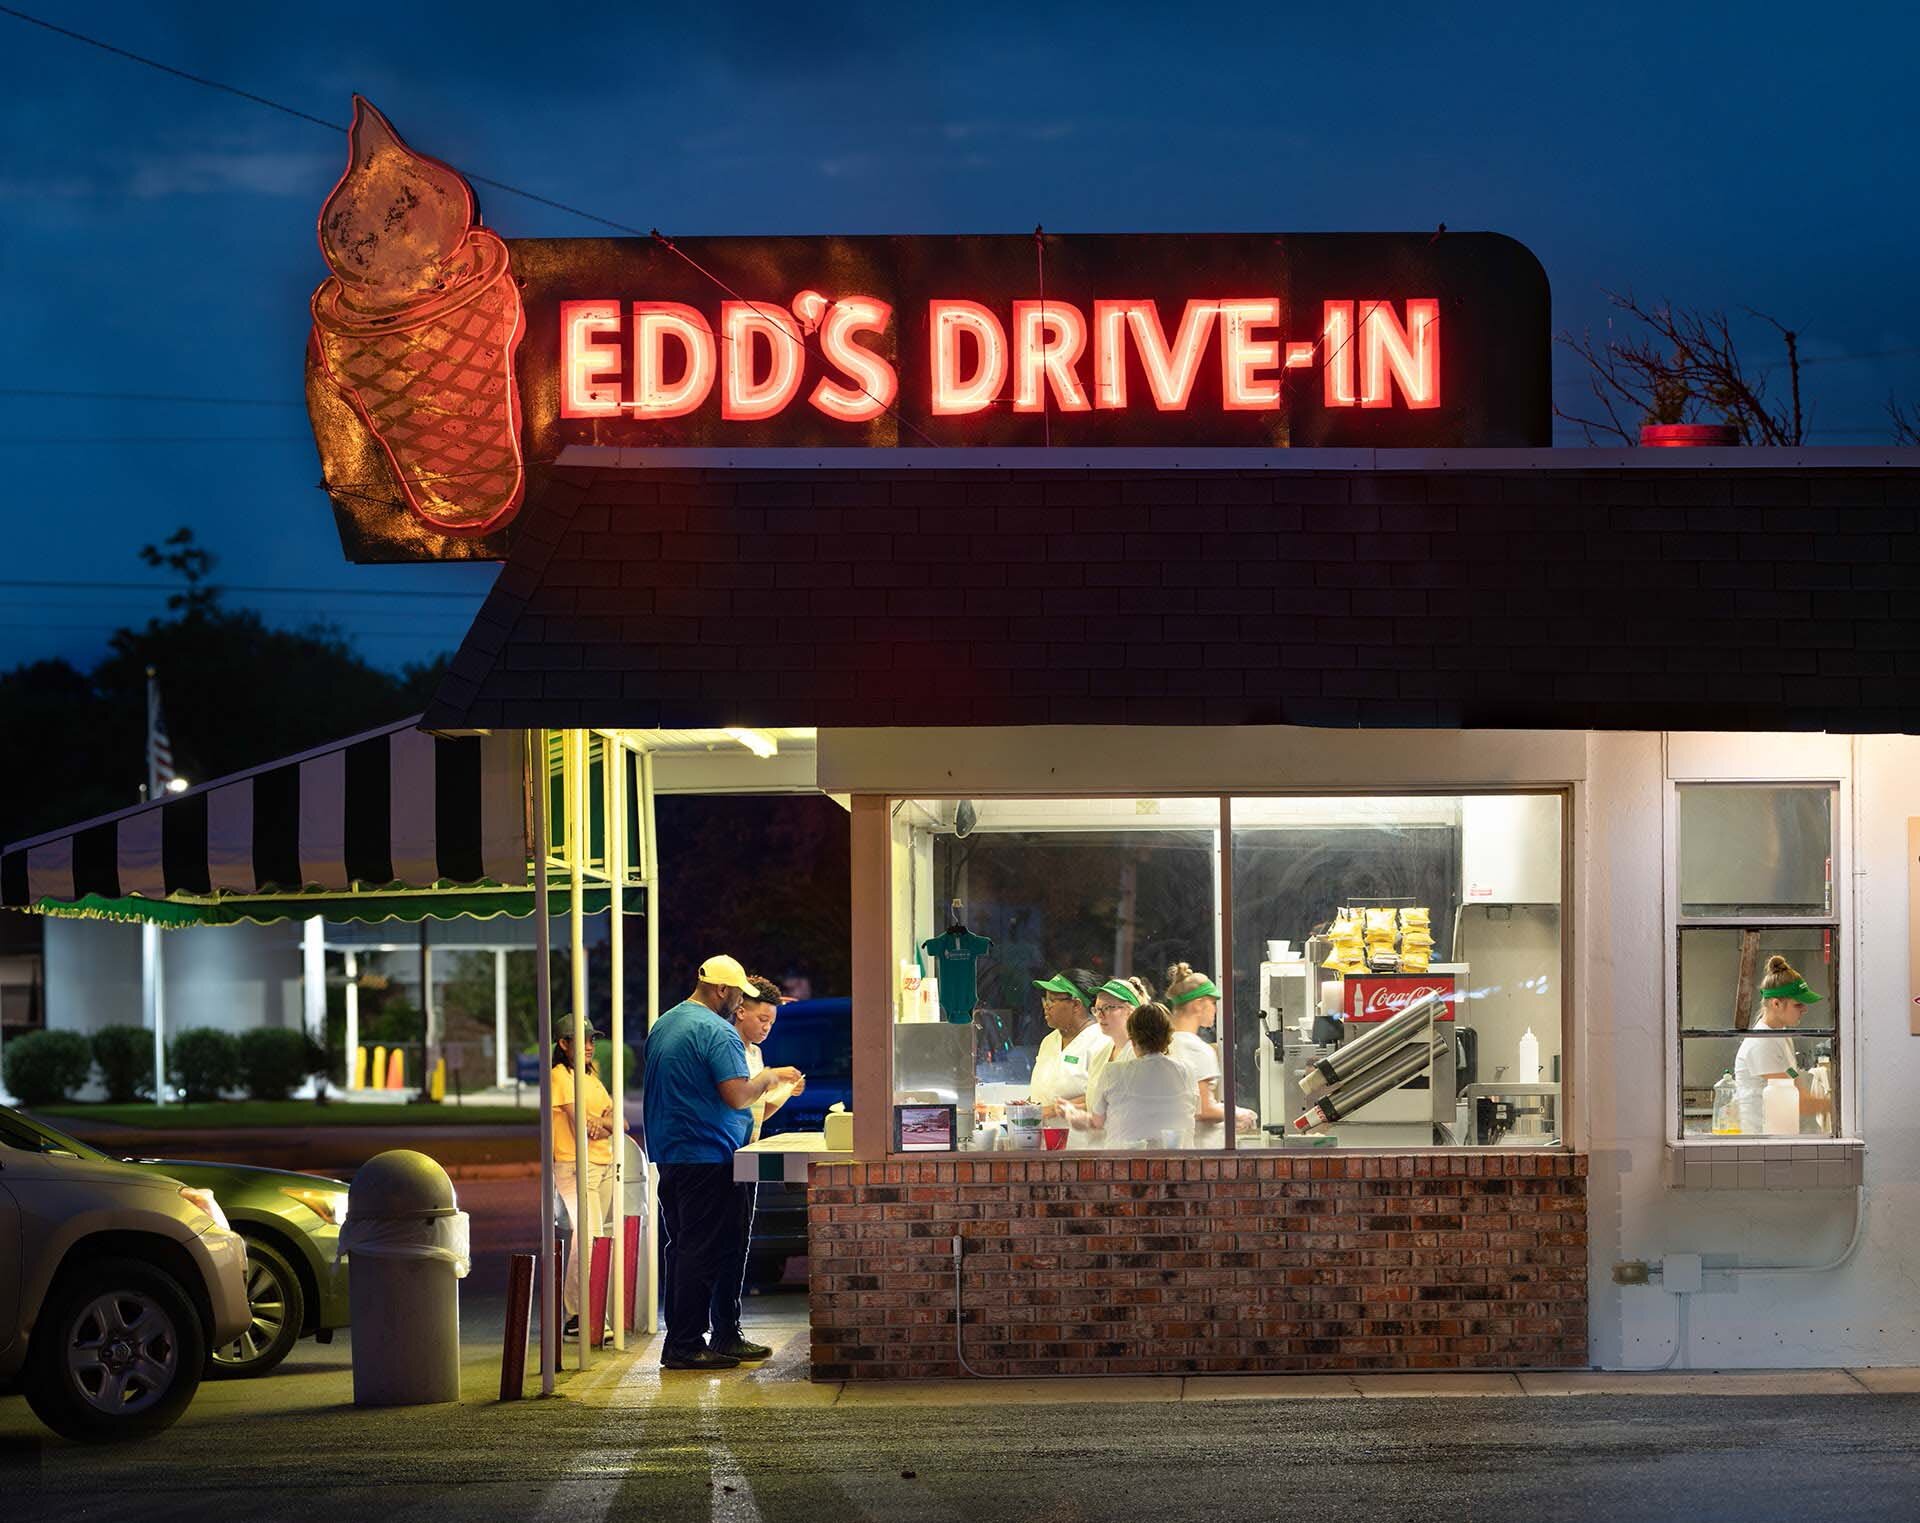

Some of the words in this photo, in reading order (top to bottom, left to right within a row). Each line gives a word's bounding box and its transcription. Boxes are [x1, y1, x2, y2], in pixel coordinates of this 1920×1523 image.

[561, 291, 897, 422] EDD'S
[930, 298, 1441, 415] DRIVE-IN
[1366, 986, 1448, 1012] Coca-C
